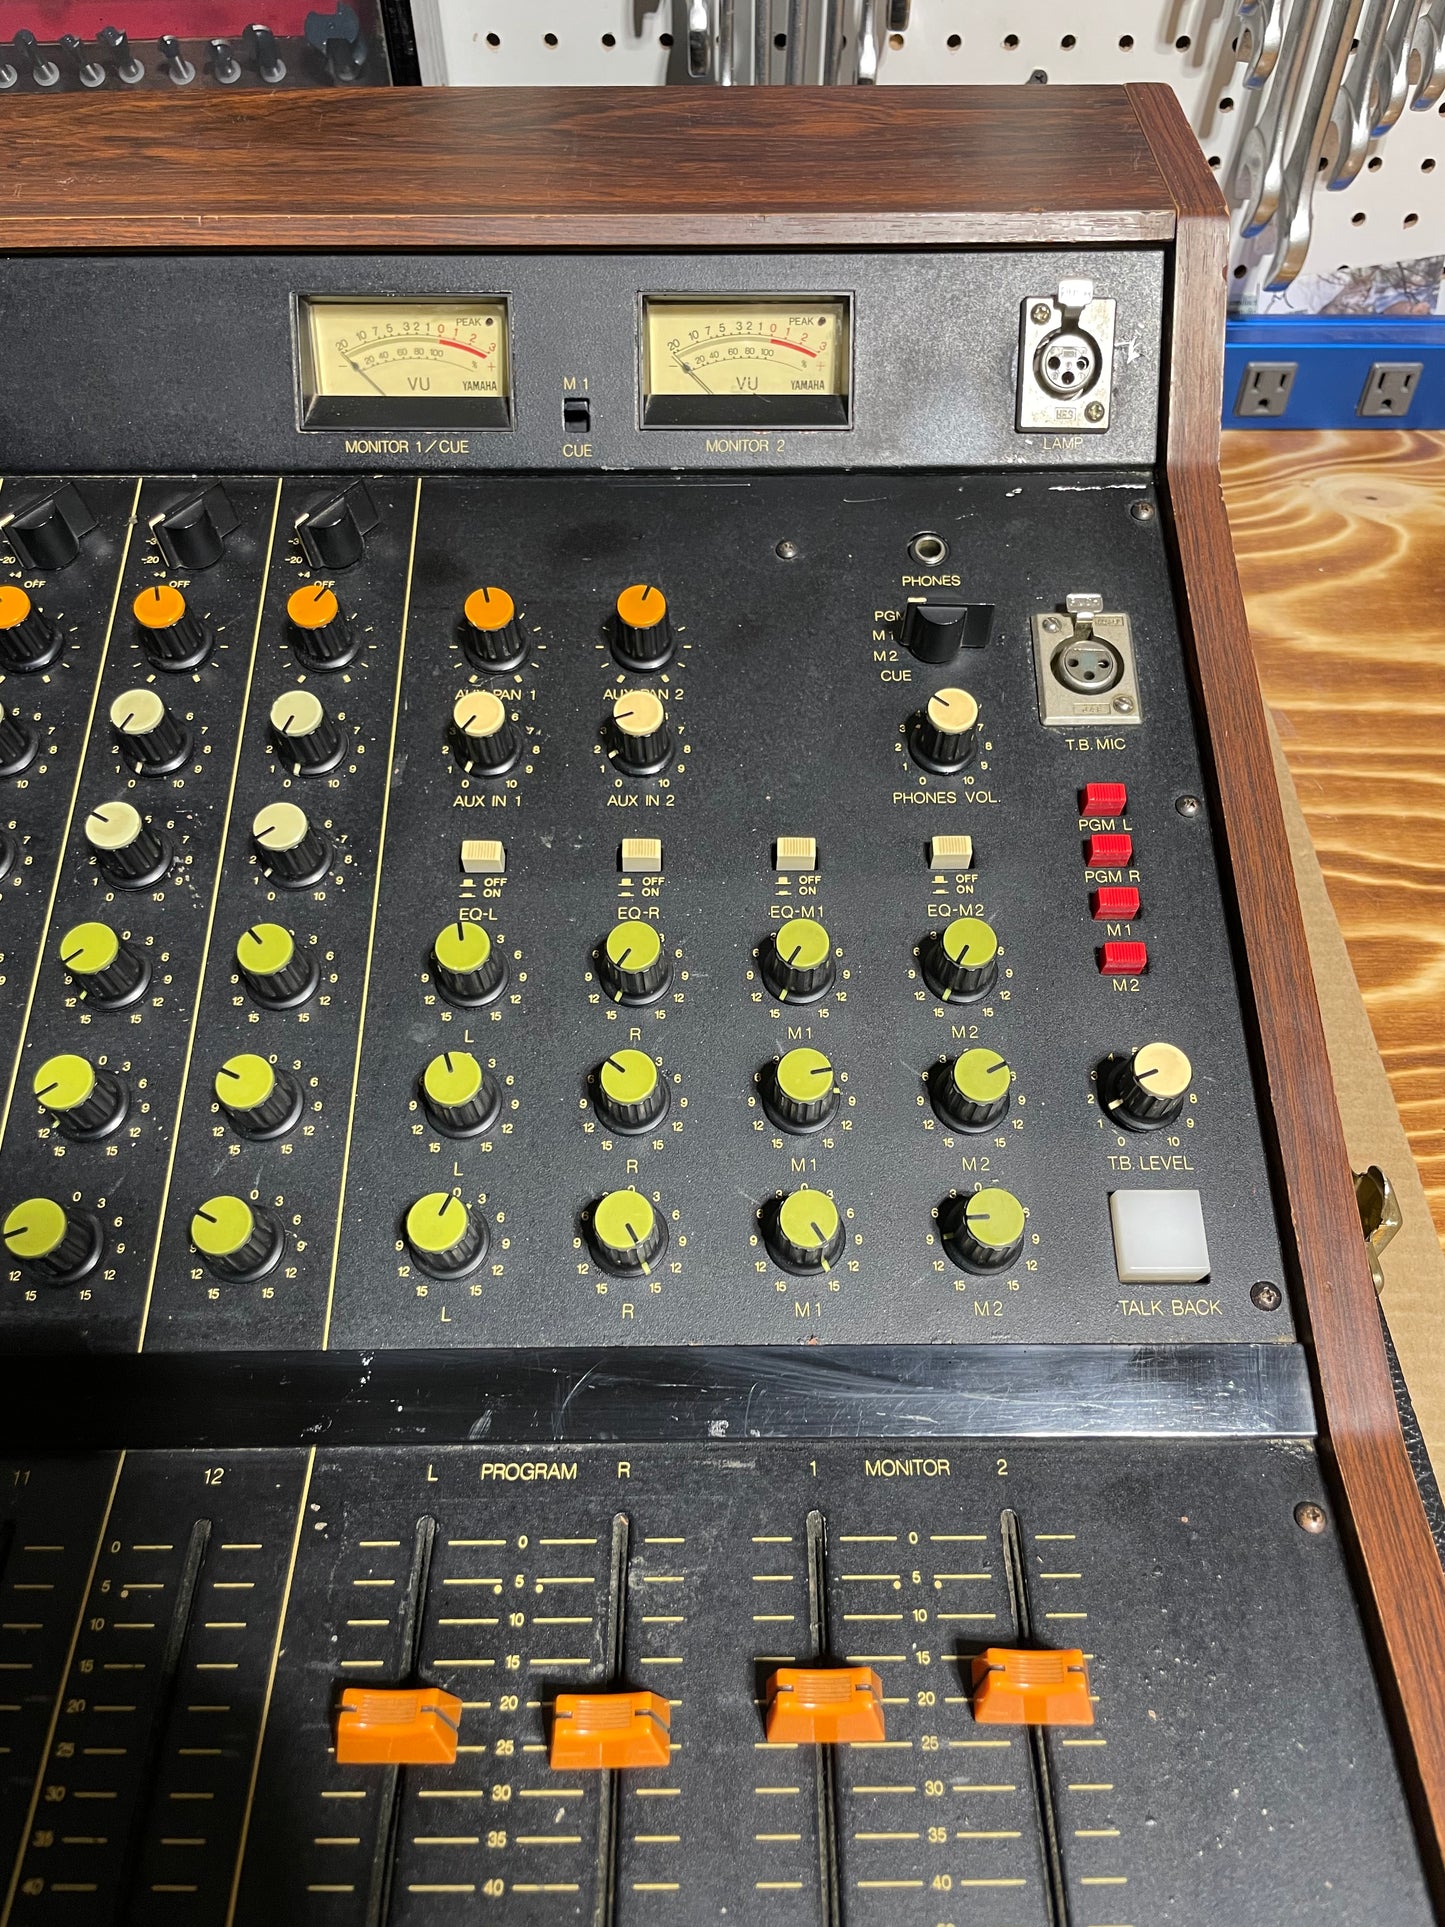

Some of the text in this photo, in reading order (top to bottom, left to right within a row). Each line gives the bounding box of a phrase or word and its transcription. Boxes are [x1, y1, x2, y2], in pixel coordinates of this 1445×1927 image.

[456, 318, 481, 327] PEAK
[789, 317, 814, 326] PEAK
[335, 322, 496, 352] 20 10 7 5 3 2 1 0 1 2 3
[667, 321, 827, 351] 20 10 7 5 3 2 1 0 1 2 3
[364, 348, 443, 365] 20 40 60 80 100
[695, 356, 705, 364] 20
[709, 351, 719, 359] 40
[728, 348, 738, 356] 60
[761, 349, 774, 357] 100
[407, 377, 430, 391] VU
[463, 381, 497, 391] YAMAHA
[736, 377, 759, 390] VU
[791, 380, 825, 390] YAMAHA
[345, 440, 409, 454] MONITOR
[706, 440, 785, 452] MONITOR 2
[1043, 437, 1083, 449] LAMP
[563, 444, 592, 457] CUE
[24, 580, 46, 588] OFF
[169, 580, 190, 588] OFF
[314, 580, 336, 588] OFF
[902, 575, 961, 587] PHONES
[880, 670, 912, 681] CUE
[493, 689, 521, 700] PAN
[530, 690, 536, 700] 1
[675, 689, 684, 700] 2
[338, 712, 346, 721] 6
[985, 742, 992, 750] 8
[1097, 738, 1126, 750] MIC
[349, 765, 356, 773] 9
[525, 765, 533, 774] 9
[283, 779, 291, 788] 0
[327, 779, 340, 788] 10
[462, 779, 469, 788] 0
[506, 779, 517, 788] 10
[919, 777, 926, 785] 0
[963, 776, 974, 785] 10
[453, 795, 521, 807] AUX IN 1
[607, 795, 675, 807] AUX IN 2
[893, 792, 957, 804] PHONES
[1079, 819, 1132, 831] PGM L
[484, 878, 507, 887] OFF
[642, 877, 665, 886] OFF
[799, 876, 821, 884] OFF
[955, 874, 978, 883] OFF
[1085, 870, 1140, 883] PGM R
[483, 889, 501, 897] ON
[641, 888, 659, 896] ON
[799, 887, 816, 895] ON
[956, 885, 974, 894] ON
[459, 908, 497, 921] EQ-L
[618, 907, 659, 919] EQ-R
[497, 935, 504, 943] 3
[514, 951, 522, 959] 6
[424, 996, 435, 1005] 12
[441, 1012, 452, 1021] 15
[491, 1011, 501, 1020] 15
[933, 1008, 944, 1017] 15
[982, 1008, 993, 1017] 15
[464, 1030, 474, 1043] L
[630, 1028, 641, 1040] R
[1189, 1094, 1197, 1104] 8
[841, 1121, 852, 1130] 12
[823, 1139, 834, 1148] 15
[1167, 1137, 1180, 1146] 10
[627, 1160, 638, 1173] R
[1140, 1156, 1194, 1170] LEVEL
[454, 1163, 463, 1176] L
[285, 1268, 297, 1278] 12
[492, 1266, 503, 1275] 12
[671, 1264, 682, 1273] 12
[208, 1288, 220, 1299] 15
[262, 1287, 274, 1299] 15
[623, 1304, 634, 1318] R
[1118, 1300, 1222, 1316] TALK BACK
[441, 1307, 451, 1322] L
[427, 1462, 630, 1481] L PROGRAM R
[810, 1459, 1008, 1476] 1 MONITOR 2
[12, 1471, 31, 1486] 11
[205, 1469, 225, 1485] 12
[518, 1536, 528, 1548] 0
[908, 1532, 918, 1544] 0
[515, 1575, 524, 1588] 5
[912, 1571, 921, 1583] 5
[509, 1613, 524, 1627] 10
[912, 1609, 927, 1622] 10
[505, 1655, 520, 1669] 15
[915, 1651, 930, 1664] 15
[500, 1695, 518, 1710] 20
[917, 1691, 935, 1706] 20
[495, 1740, 514, 1755] 25
[921, 1736, 939, 1750] 25
[492, 1785, 511, 1801] 30
[925, 1781, 943, 1796] 30
[487, 1831, 507, 1848] 35
[928, 1827, 947, 1843] 35
[483, 1879, 504, 1896] 40
[932, 1875, 952, 1891] 40
